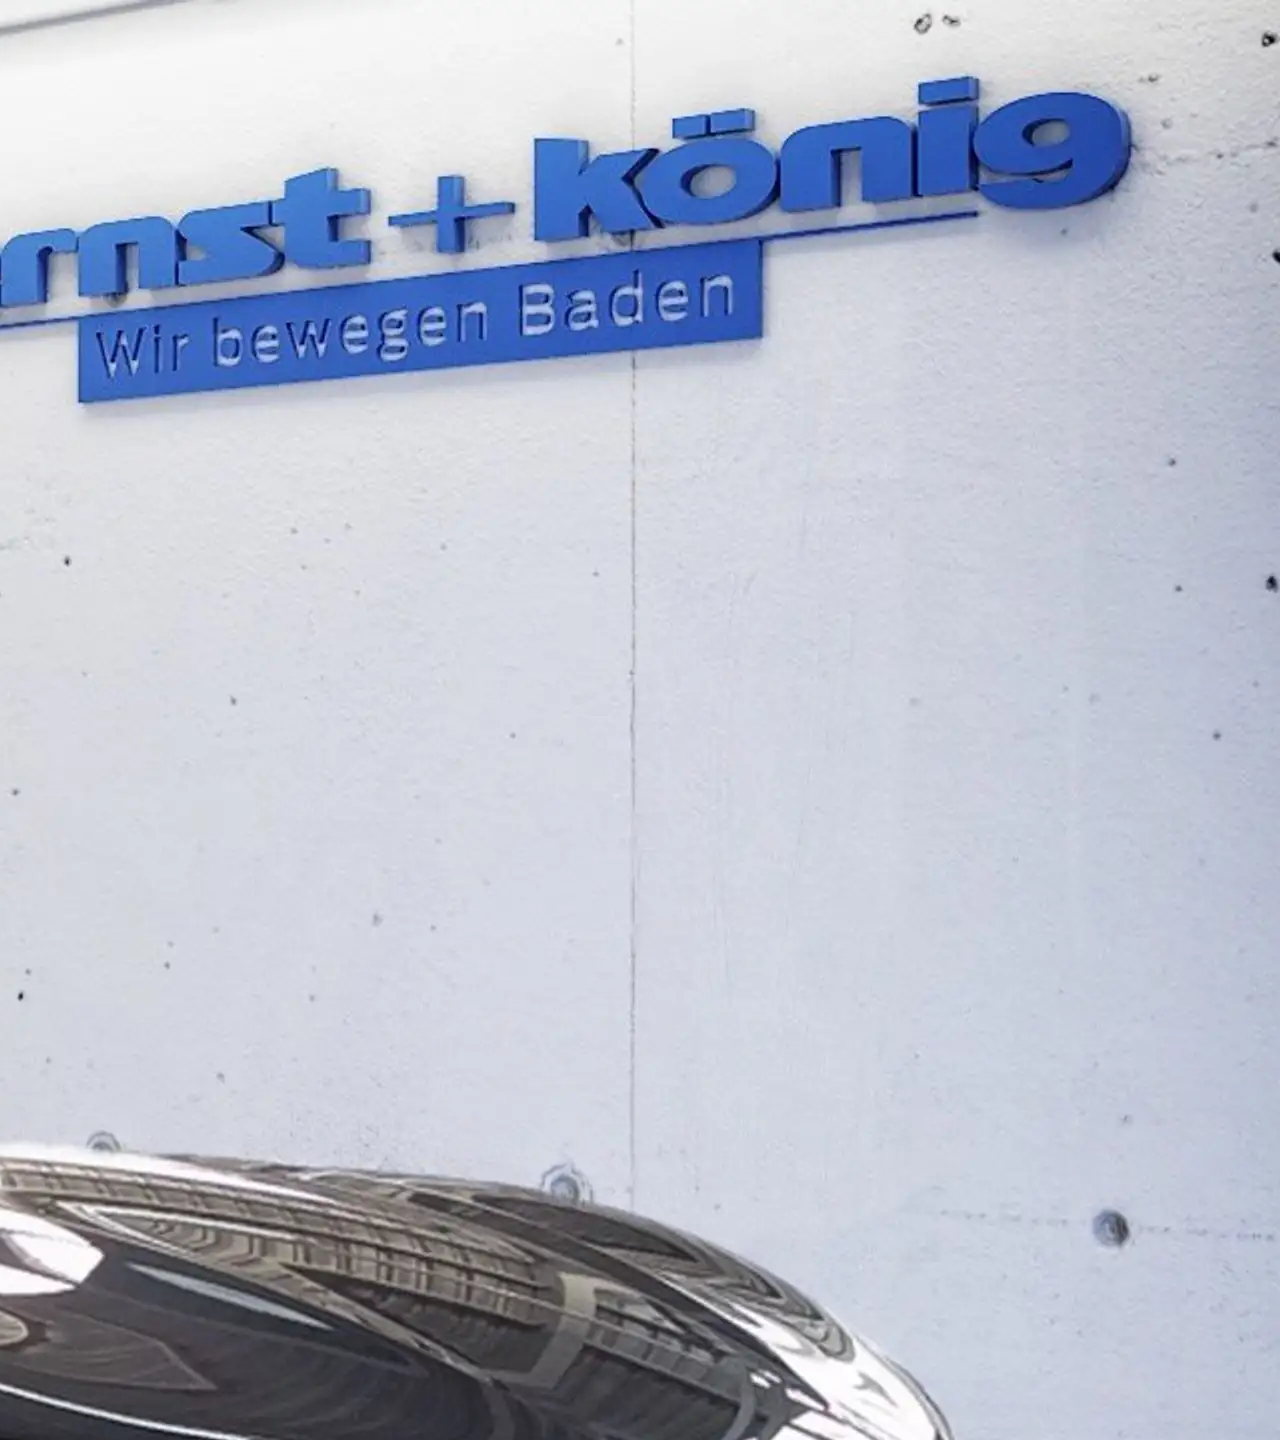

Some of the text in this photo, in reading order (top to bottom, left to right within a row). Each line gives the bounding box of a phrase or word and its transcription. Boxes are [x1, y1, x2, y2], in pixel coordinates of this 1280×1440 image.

[95, 269, 735, 380] Wir bewegen Baden
